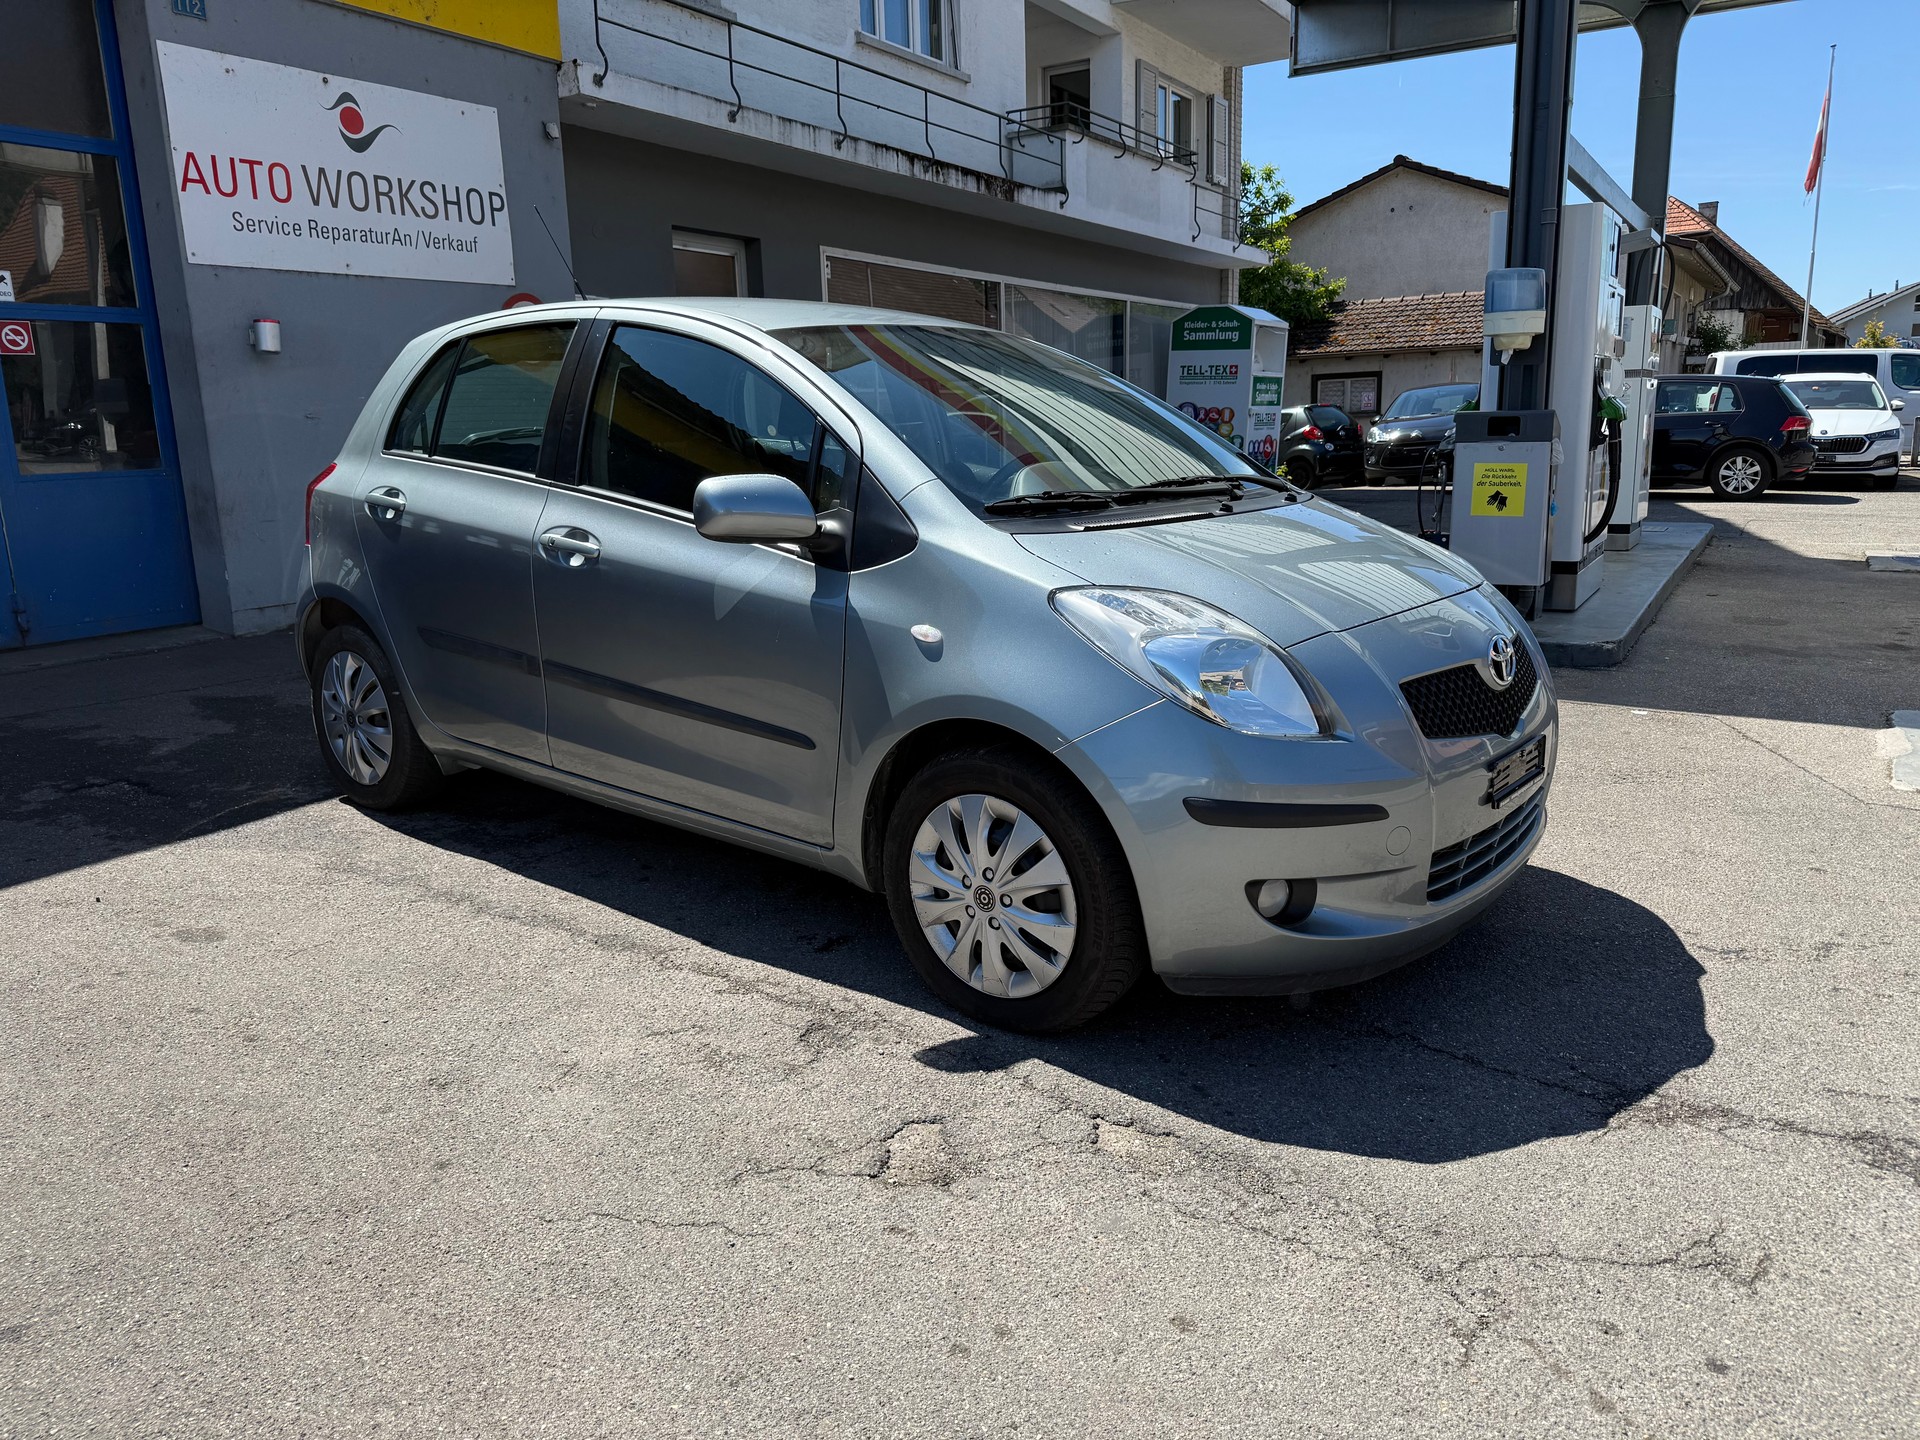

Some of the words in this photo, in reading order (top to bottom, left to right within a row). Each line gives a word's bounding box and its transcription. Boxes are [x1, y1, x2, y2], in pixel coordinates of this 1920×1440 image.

[181, 151, 292, 203] AUTO
[301, 164, 505, 227] WORKSHOP
[232, 211, 302, 237] Service
[308, 219, 478, 253] ReparaturAn/Verkauf
[1184, 320, 1210, 329] Kleider-
[1218, 319, 1241, 328] Schuh-
[1183, 328, 1240, 343] Sammlung
[1180, 364, 1229, 376] TELL-TEX
